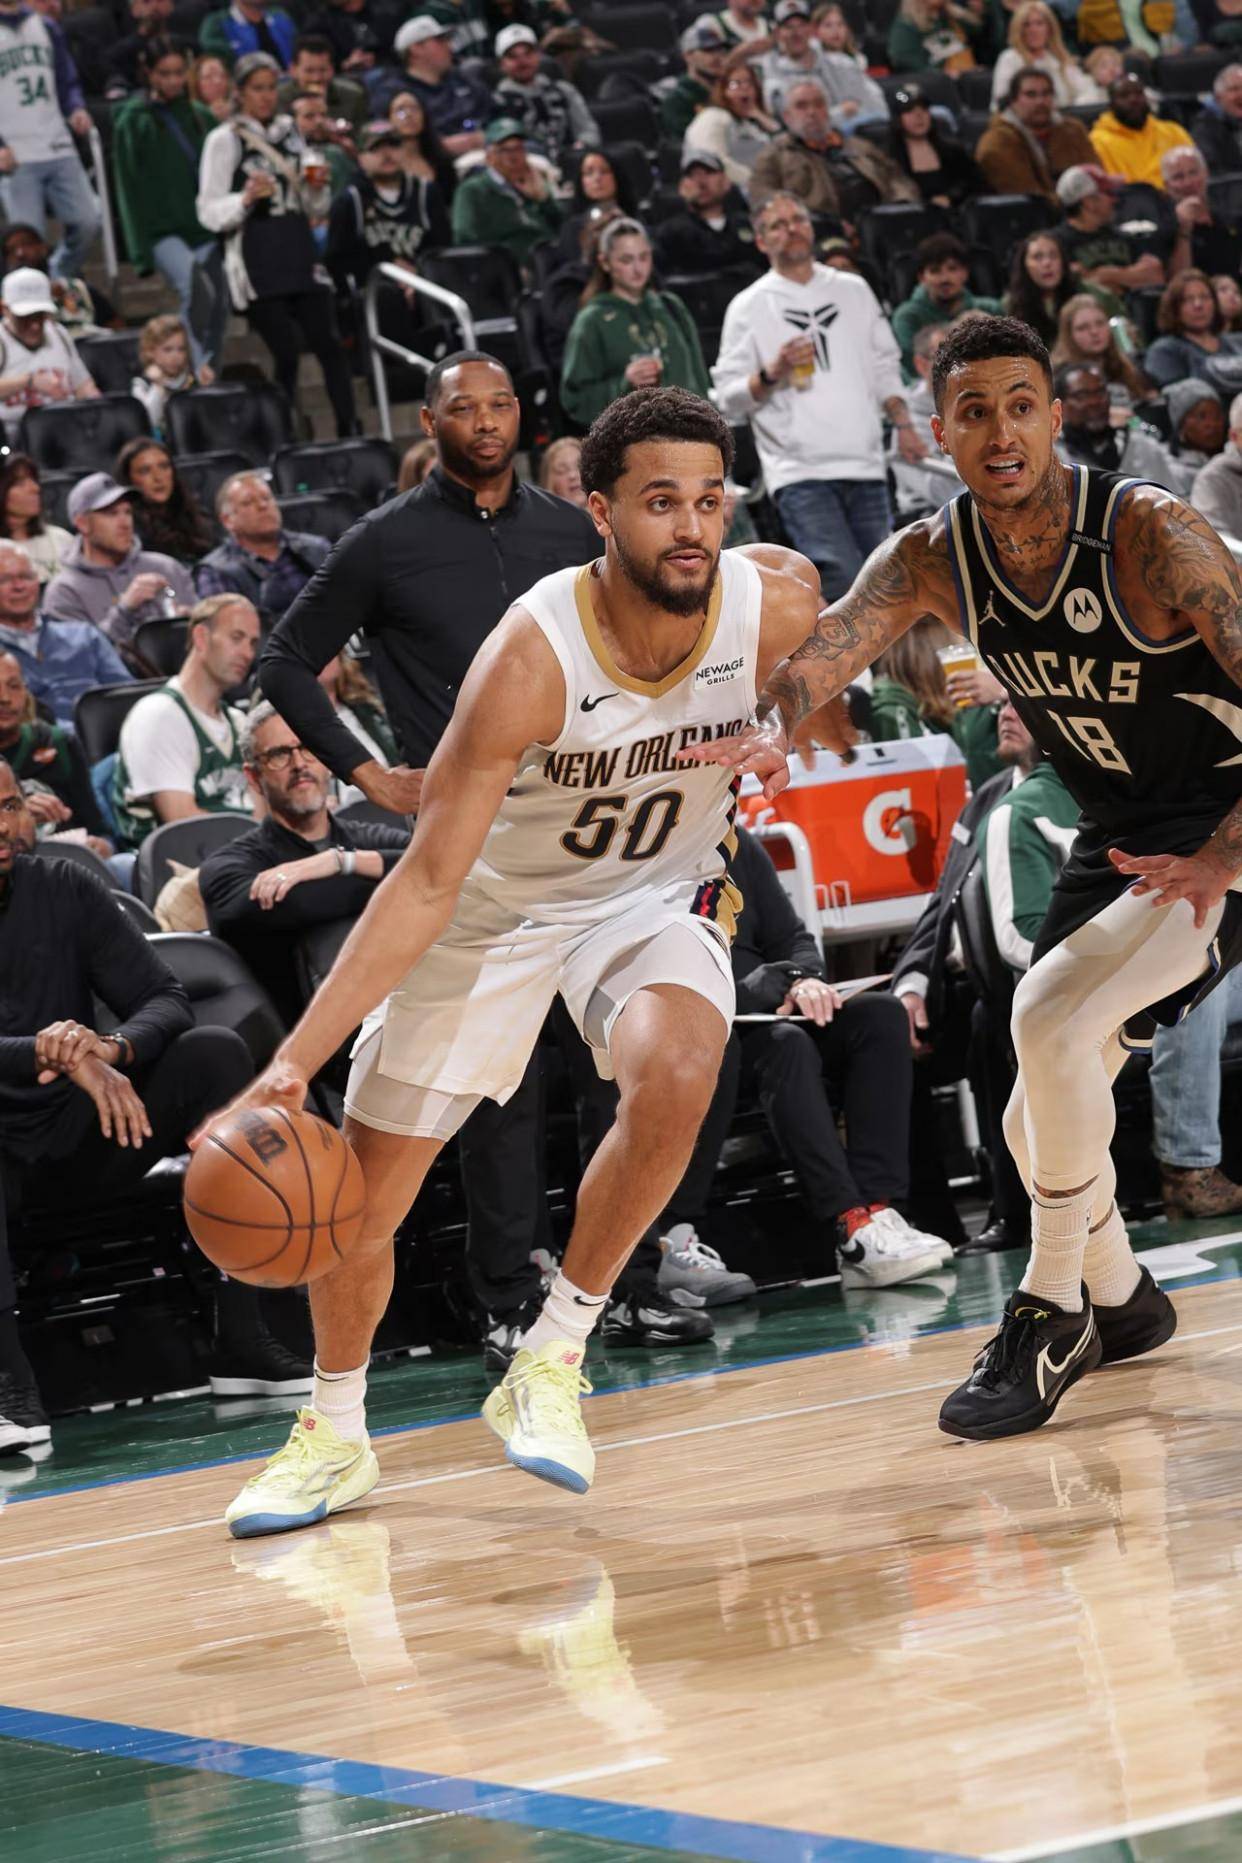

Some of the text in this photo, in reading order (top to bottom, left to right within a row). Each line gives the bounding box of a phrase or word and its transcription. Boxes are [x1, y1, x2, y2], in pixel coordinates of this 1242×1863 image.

[17, 75, 49, 107] 34
[695, 656, 744, 681] NEWAGE
[706, 673, 735, 685] GRILLS
[543, 746, 622, 788] NEW
[559, 789, 684, 861] 50
[863, 787, 917, 856] G
